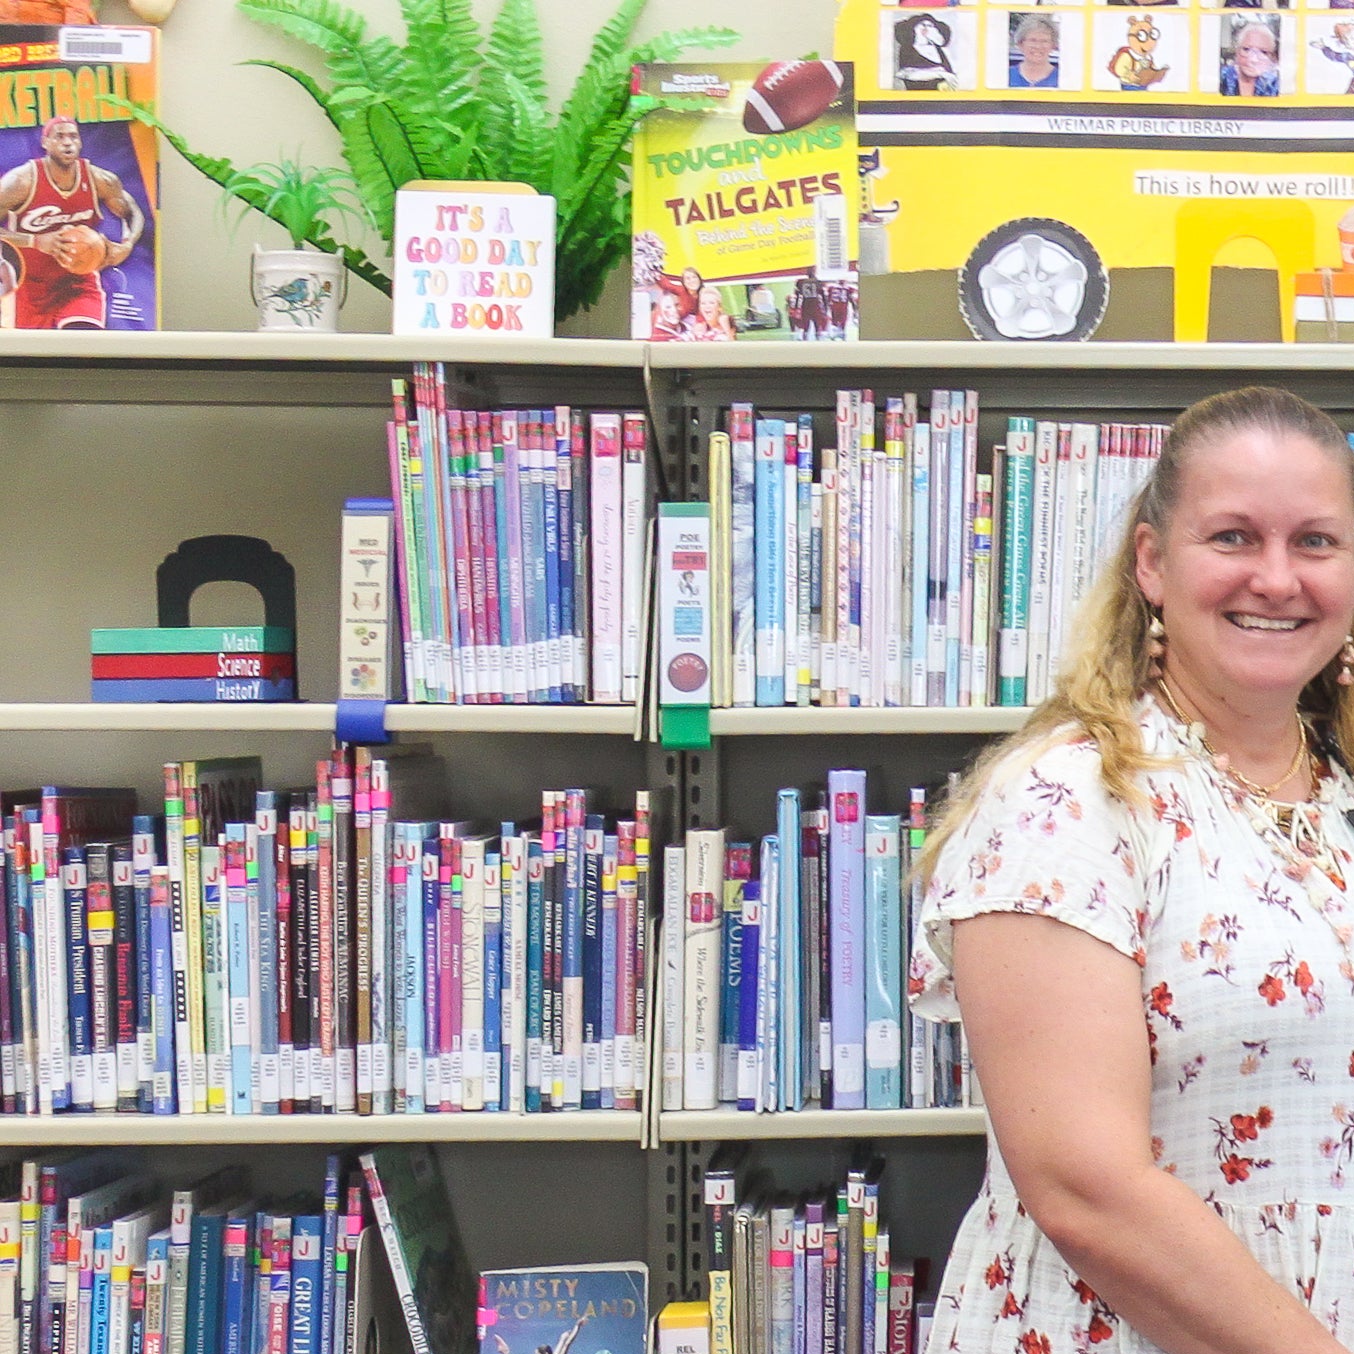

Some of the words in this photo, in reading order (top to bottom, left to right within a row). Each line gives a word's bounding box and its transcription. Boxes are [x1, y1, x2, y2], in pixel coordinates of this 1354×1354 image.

[1048, 117, 1116, 134] WEIMAR
[1121, 118, 1176, 135] PUBLIC
[1180, 119, 1245, 136] LIBRARY
[649, 124, 843, 178] TOUCHDOWNS
[716, 156, 769, 187] and
[1136, 175, 1180, 195] This
[1187, 177, 1202, 195] is
[1210, 175, 1260, 196] how
[1267, 181, 1299, 197] we
[665, 172, 844, 226] TAILGATES
[435, 204, 485, 232] IT'S
[495, 206, 514, 233] A
[406, 236, 478, 263] GOOD
[488, 239, 542, 266] DAY
[413, 269, 448, 296] TO
[458, 270, 532, 298] READ
[420, 302, 440, 329] A
[450, 303, 523, 331] BOOK
[222, 631, 259, 652] Math
[217, 652, 261, 678] Science
[337, 862, 347, 881] Ben
[668, 856, 678, 892] EDGAR
[668, 894, 678, 928] ALLAN
[668, 933, 678, 951] POE
[729, 913, 744, 986] POEMS
[73, 946, 85, 993] President
[338, 944, 348, 1003] ALMANAC
[359, 933, 369, 991] PROGRESS
[842, 941, 852, 986] POETRY
[406, 956, 416, 998] JACKSON
[96, 1280, 107, 1316] Twenty
[496, 1278, 579, 1299] MISTY
[715, 1277, 727, 1291] Be
[293, 1278, 312, 1335] GREAT
[494, 1299, 637, 1320] COPELAND
[715, 1296, 727, 1320] Not
[715, 1325, 728, 1343] Far
[677, 1345, 696, 1354] REL
